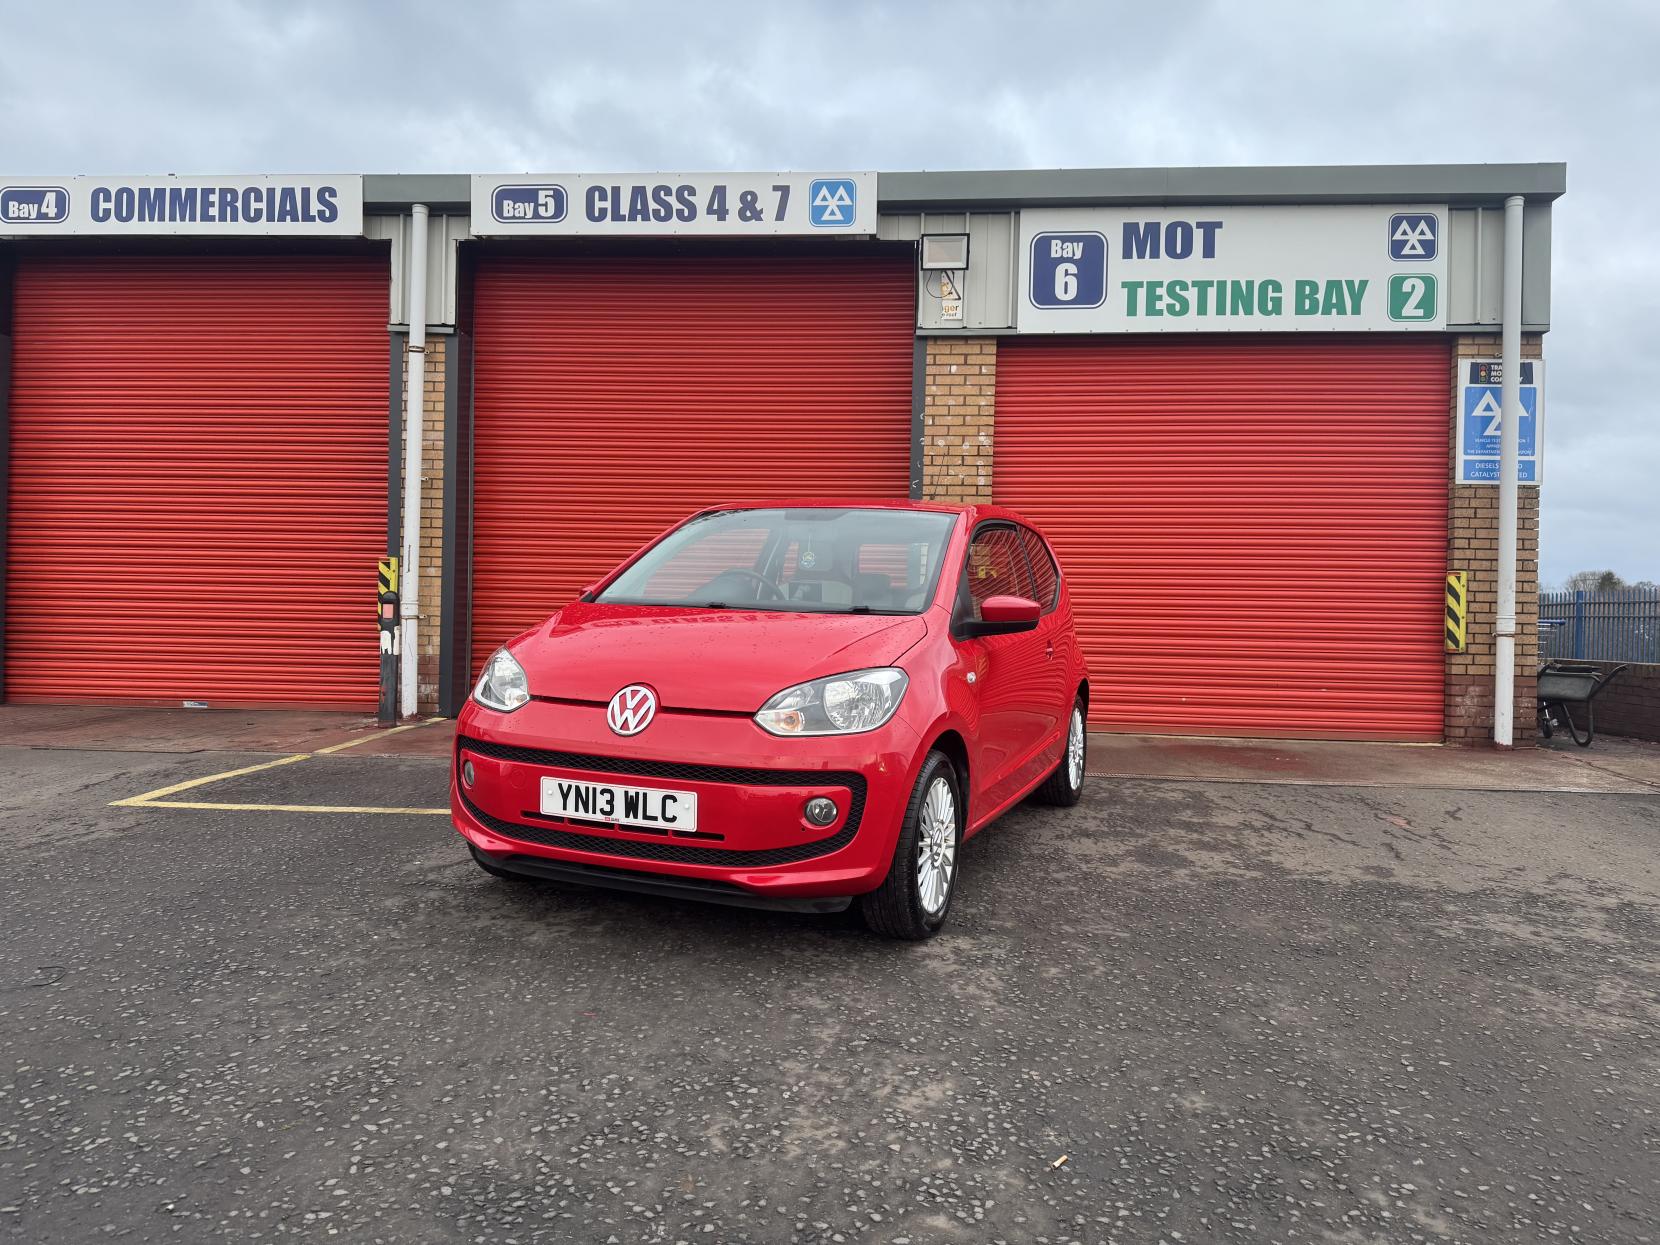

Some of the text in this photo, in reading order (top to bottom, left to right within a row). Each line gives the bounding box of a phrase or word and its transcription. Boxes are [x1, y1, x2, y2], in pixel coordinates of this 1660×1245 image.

[9, 192, 57, 219] Bay 4
[91, 186, 338, 223] COMMERCIALS
[503, 190, 554, 218] Bay 5
[586, 185, 790, 222] CLASS 4 & 7
[1051, 240, 1083, 259] Bay
[1122, 221, 1223, 259] MOT
[1055, 263, 1077, 300] 6
[1121, 279, 1369, 316] TESTING BAY
[1402, 277, 1424, 316] 2
[558, 783, 678, 823] YN13 WLC
